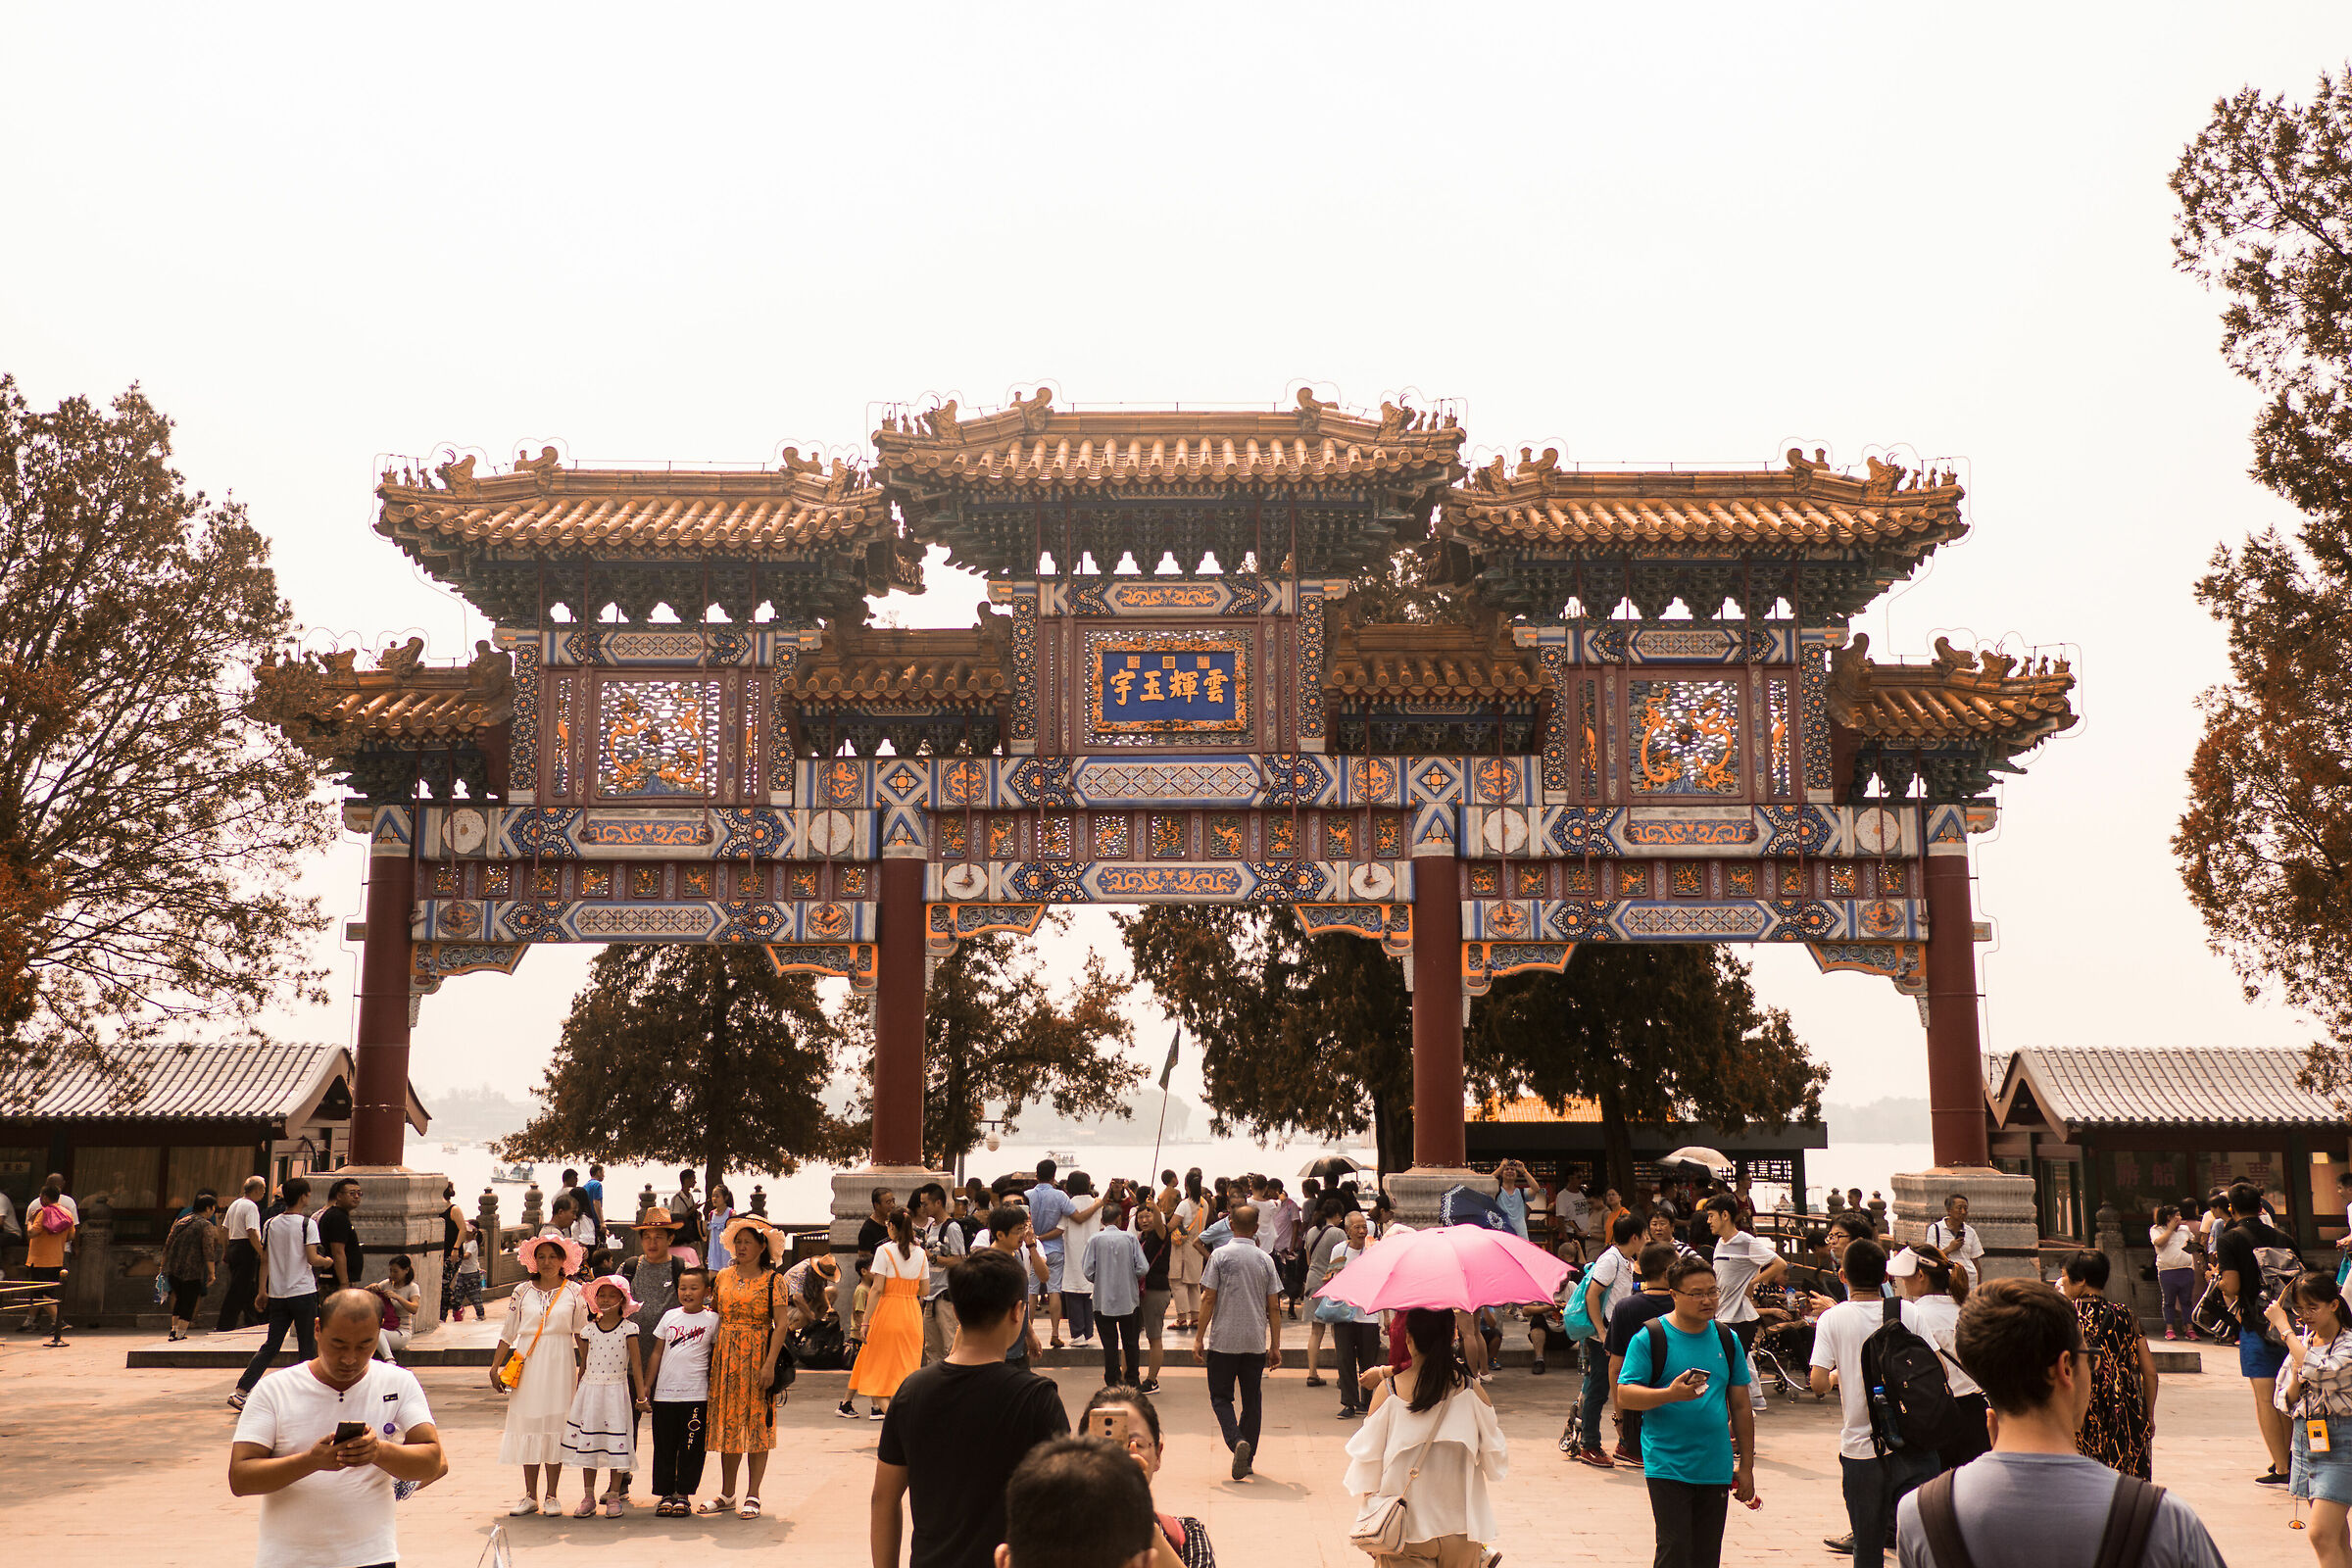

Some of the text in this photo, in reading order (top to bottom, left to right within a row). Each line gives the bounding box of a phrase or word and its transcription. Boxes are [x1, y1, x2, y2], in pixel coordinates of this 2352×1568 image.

[1109, 668, 1229, 706] 雲輝玉宇
[2116, 1161, 2271, 1187] 游船 售票
